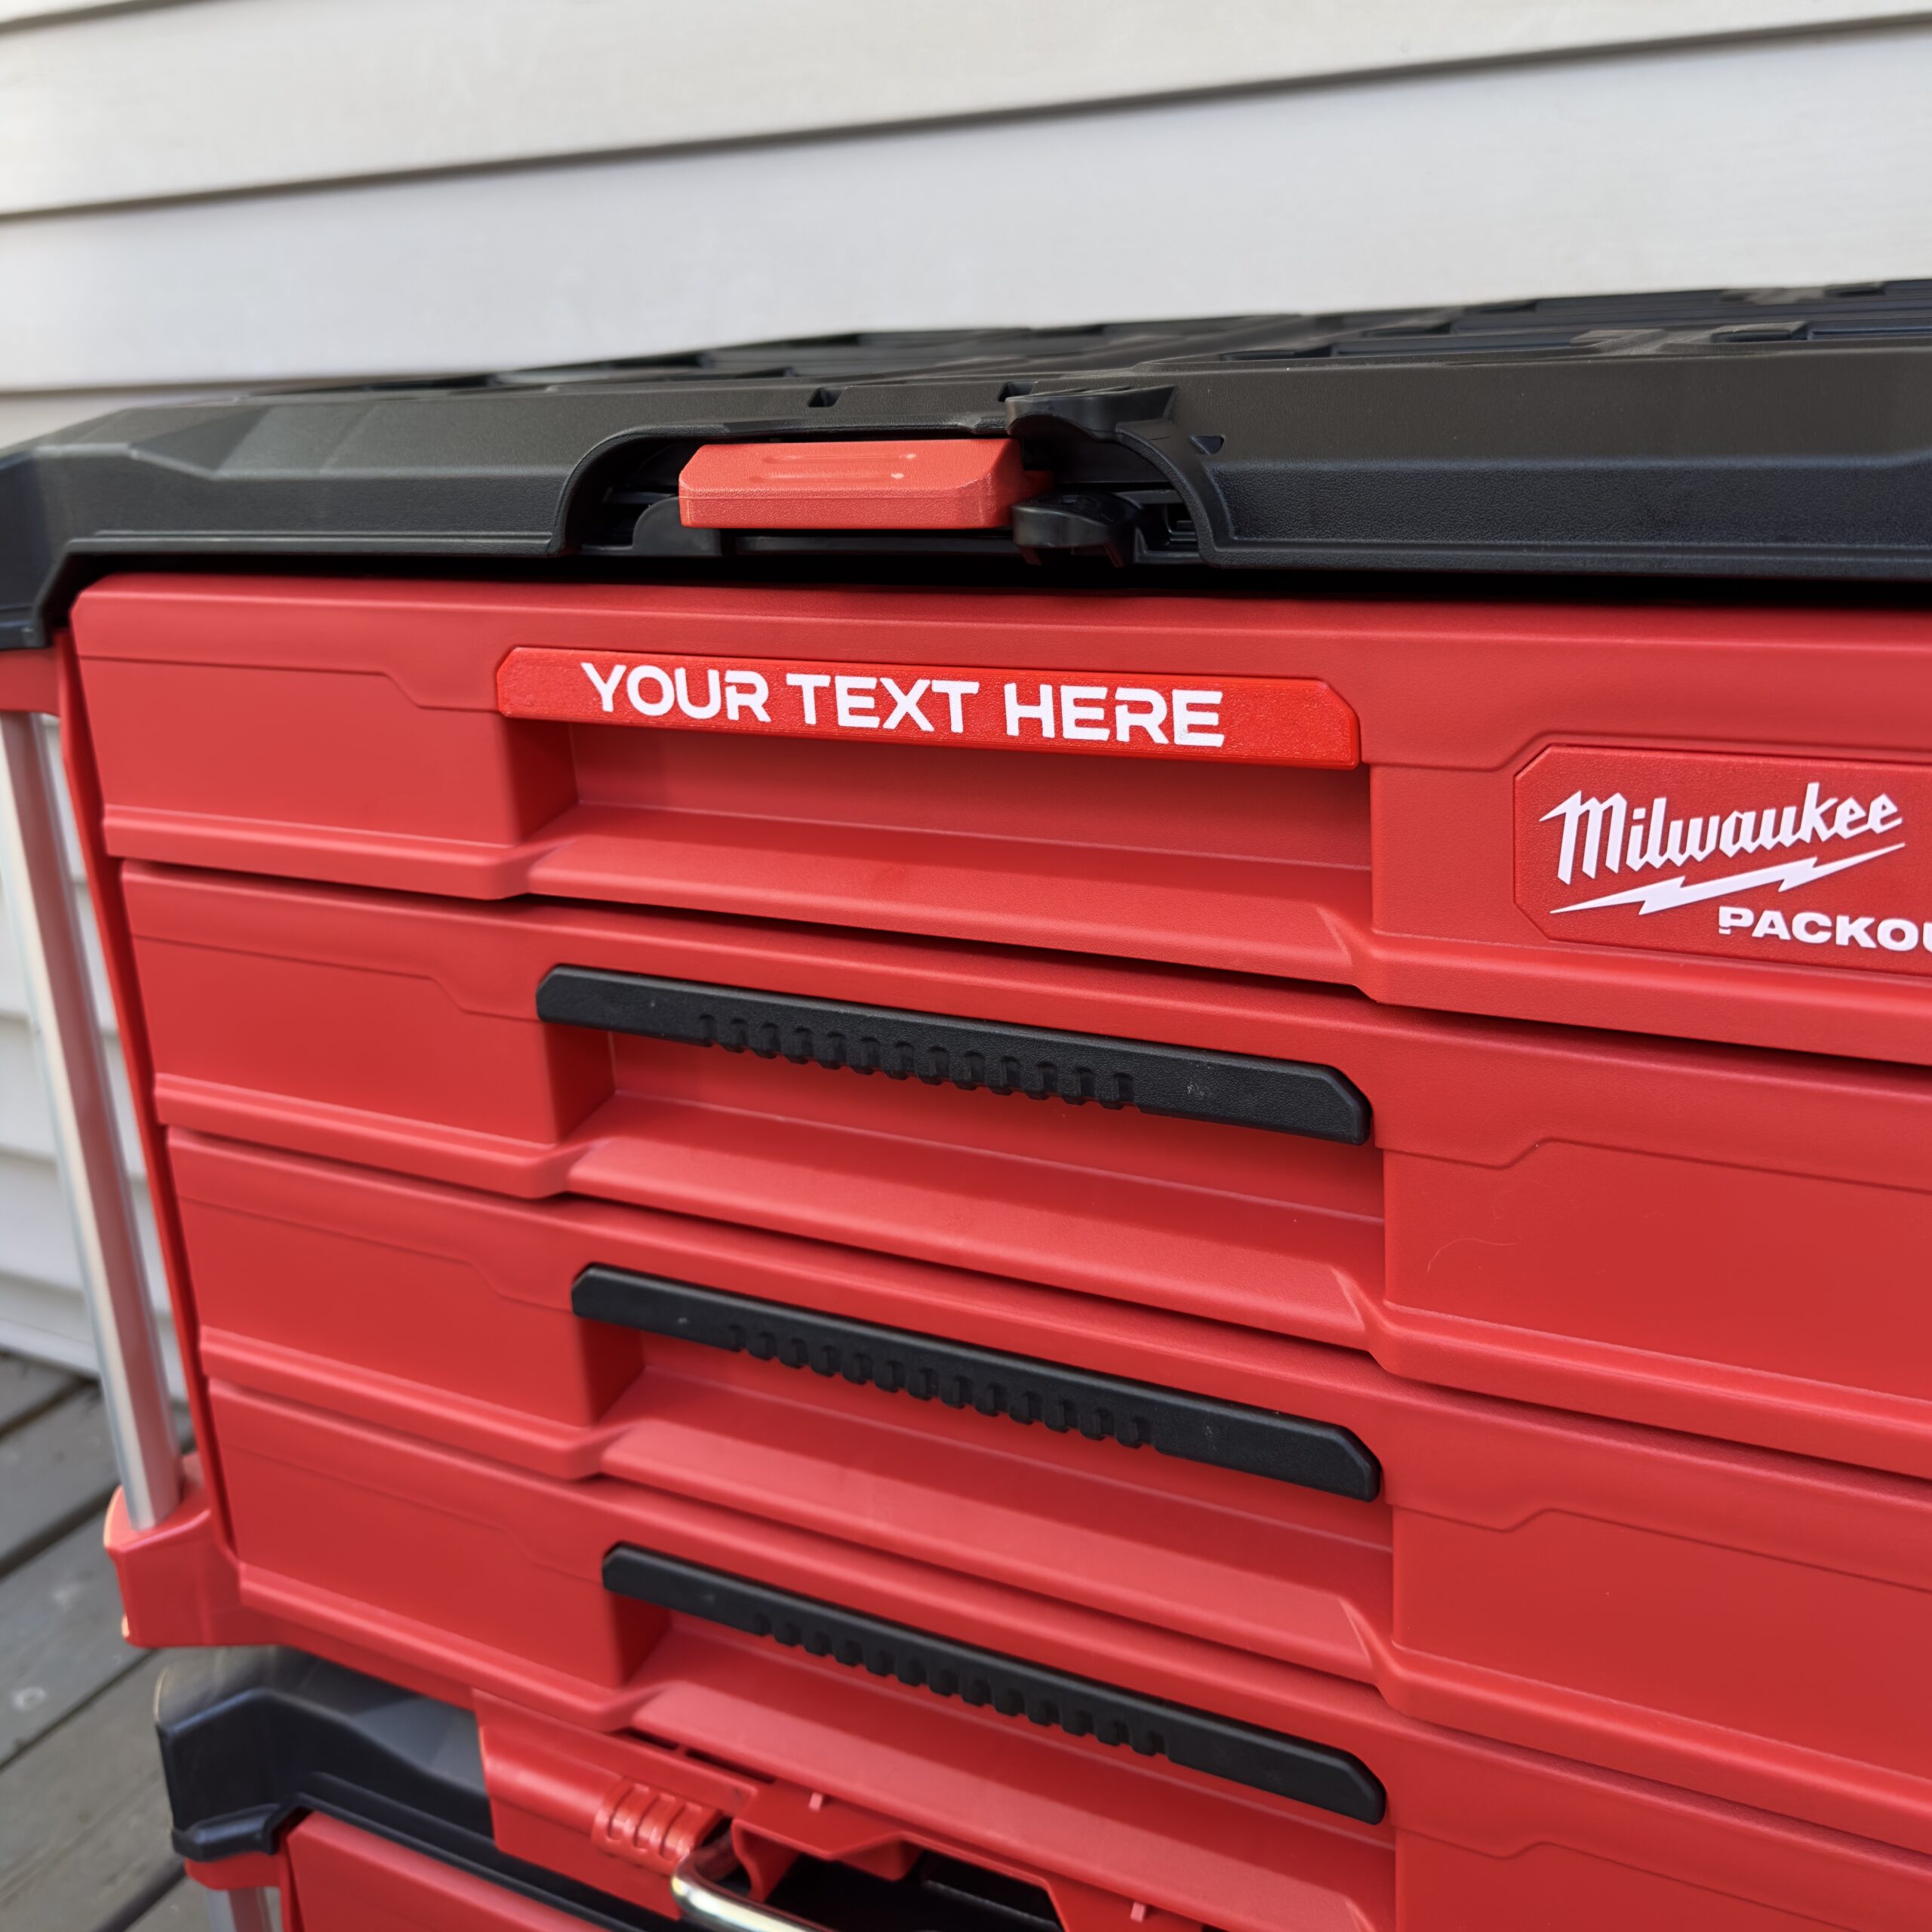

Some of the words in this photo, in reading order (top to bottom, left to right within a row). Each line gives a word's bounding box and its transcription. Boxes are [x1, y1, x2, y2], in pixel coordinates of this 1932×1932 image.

[580, 662, 772, 724] YOUR
[786, 672, 980, 734] TEXT
[1004, 682, 1225, 748] HERE
[1537, 781, 1903, 885] Milwaukee
[1718, 906, 1932, 952] PACKO
